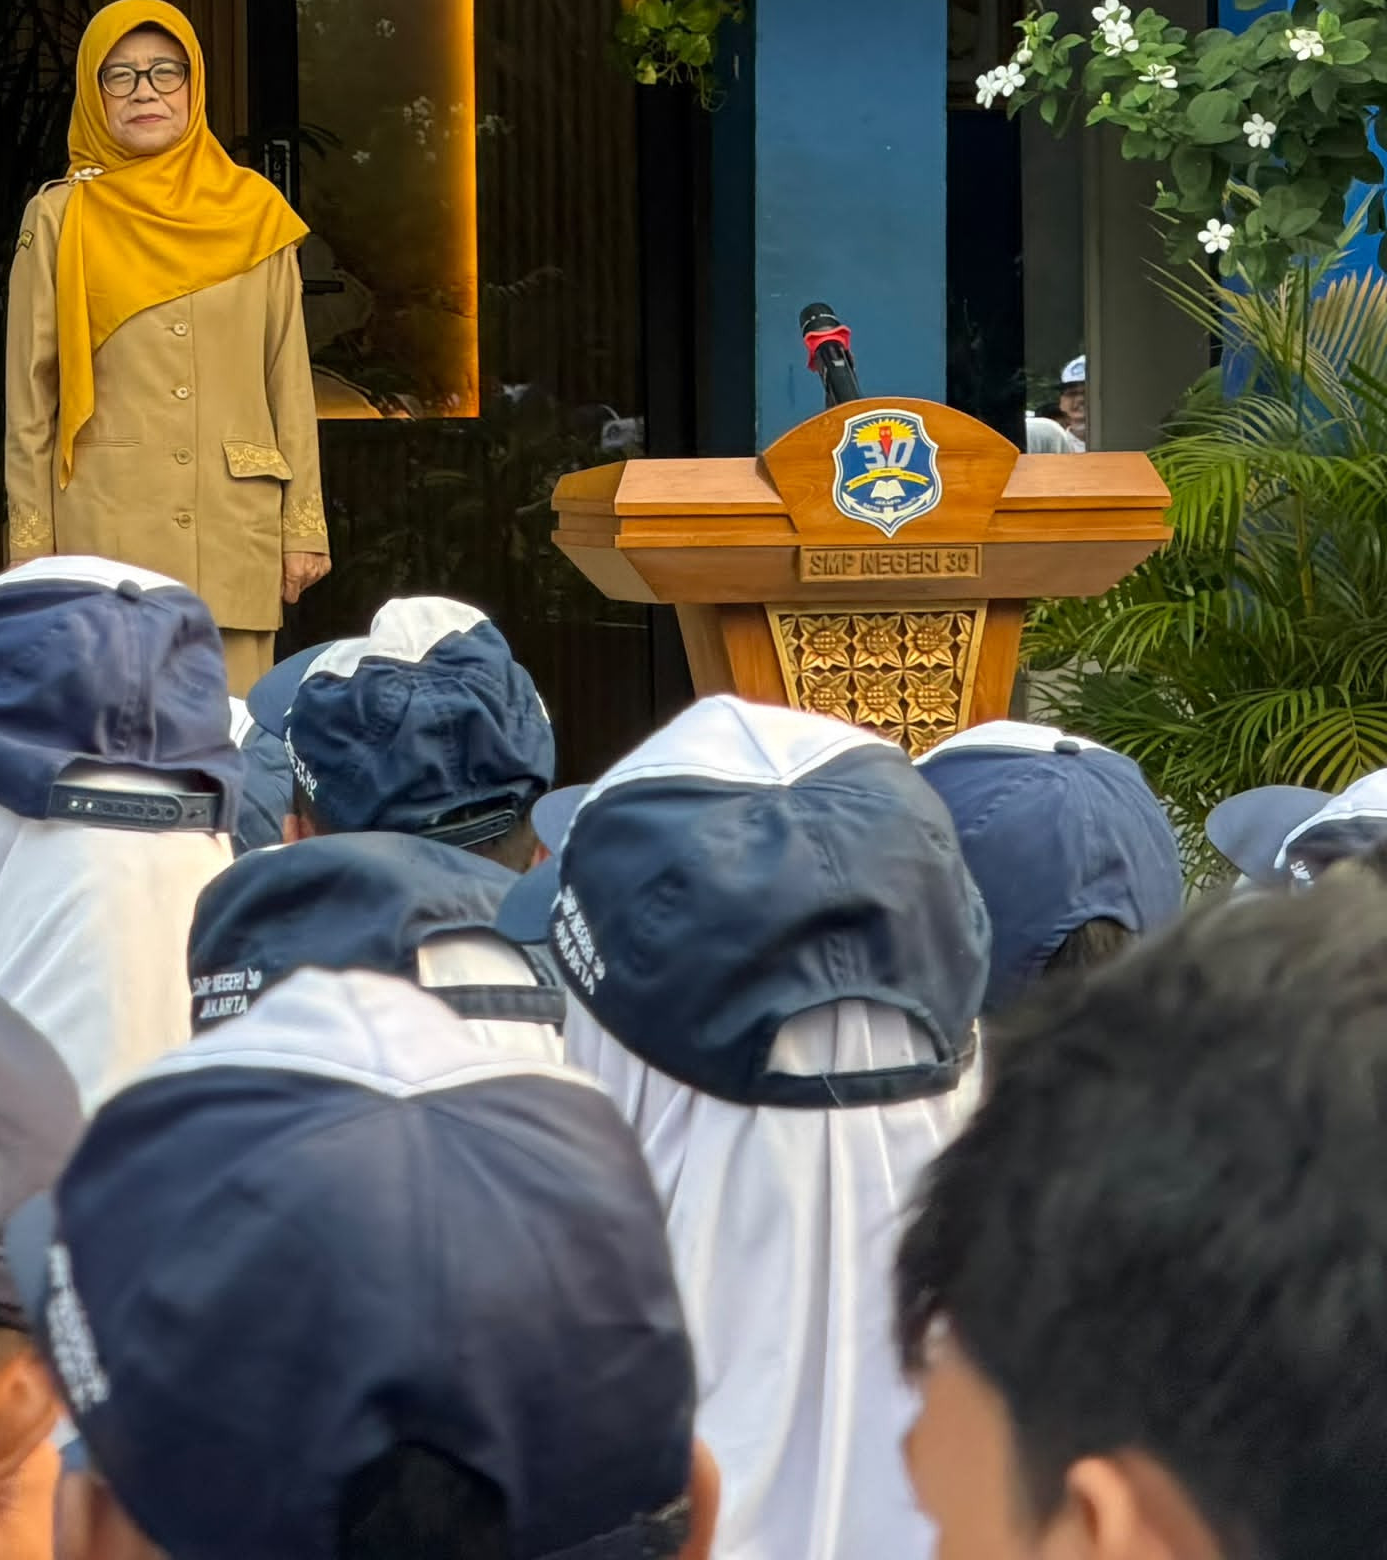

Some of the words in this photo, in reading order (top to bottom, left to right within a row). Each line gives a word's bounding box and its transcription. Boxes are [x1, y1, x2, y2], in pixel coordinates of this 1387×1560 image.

[856, 439, 916, 471] 30
[811, 552, 853, 575] SMP
[861, 551, 939, 574] NEGERI
[946, 551, 969, 572] 30
